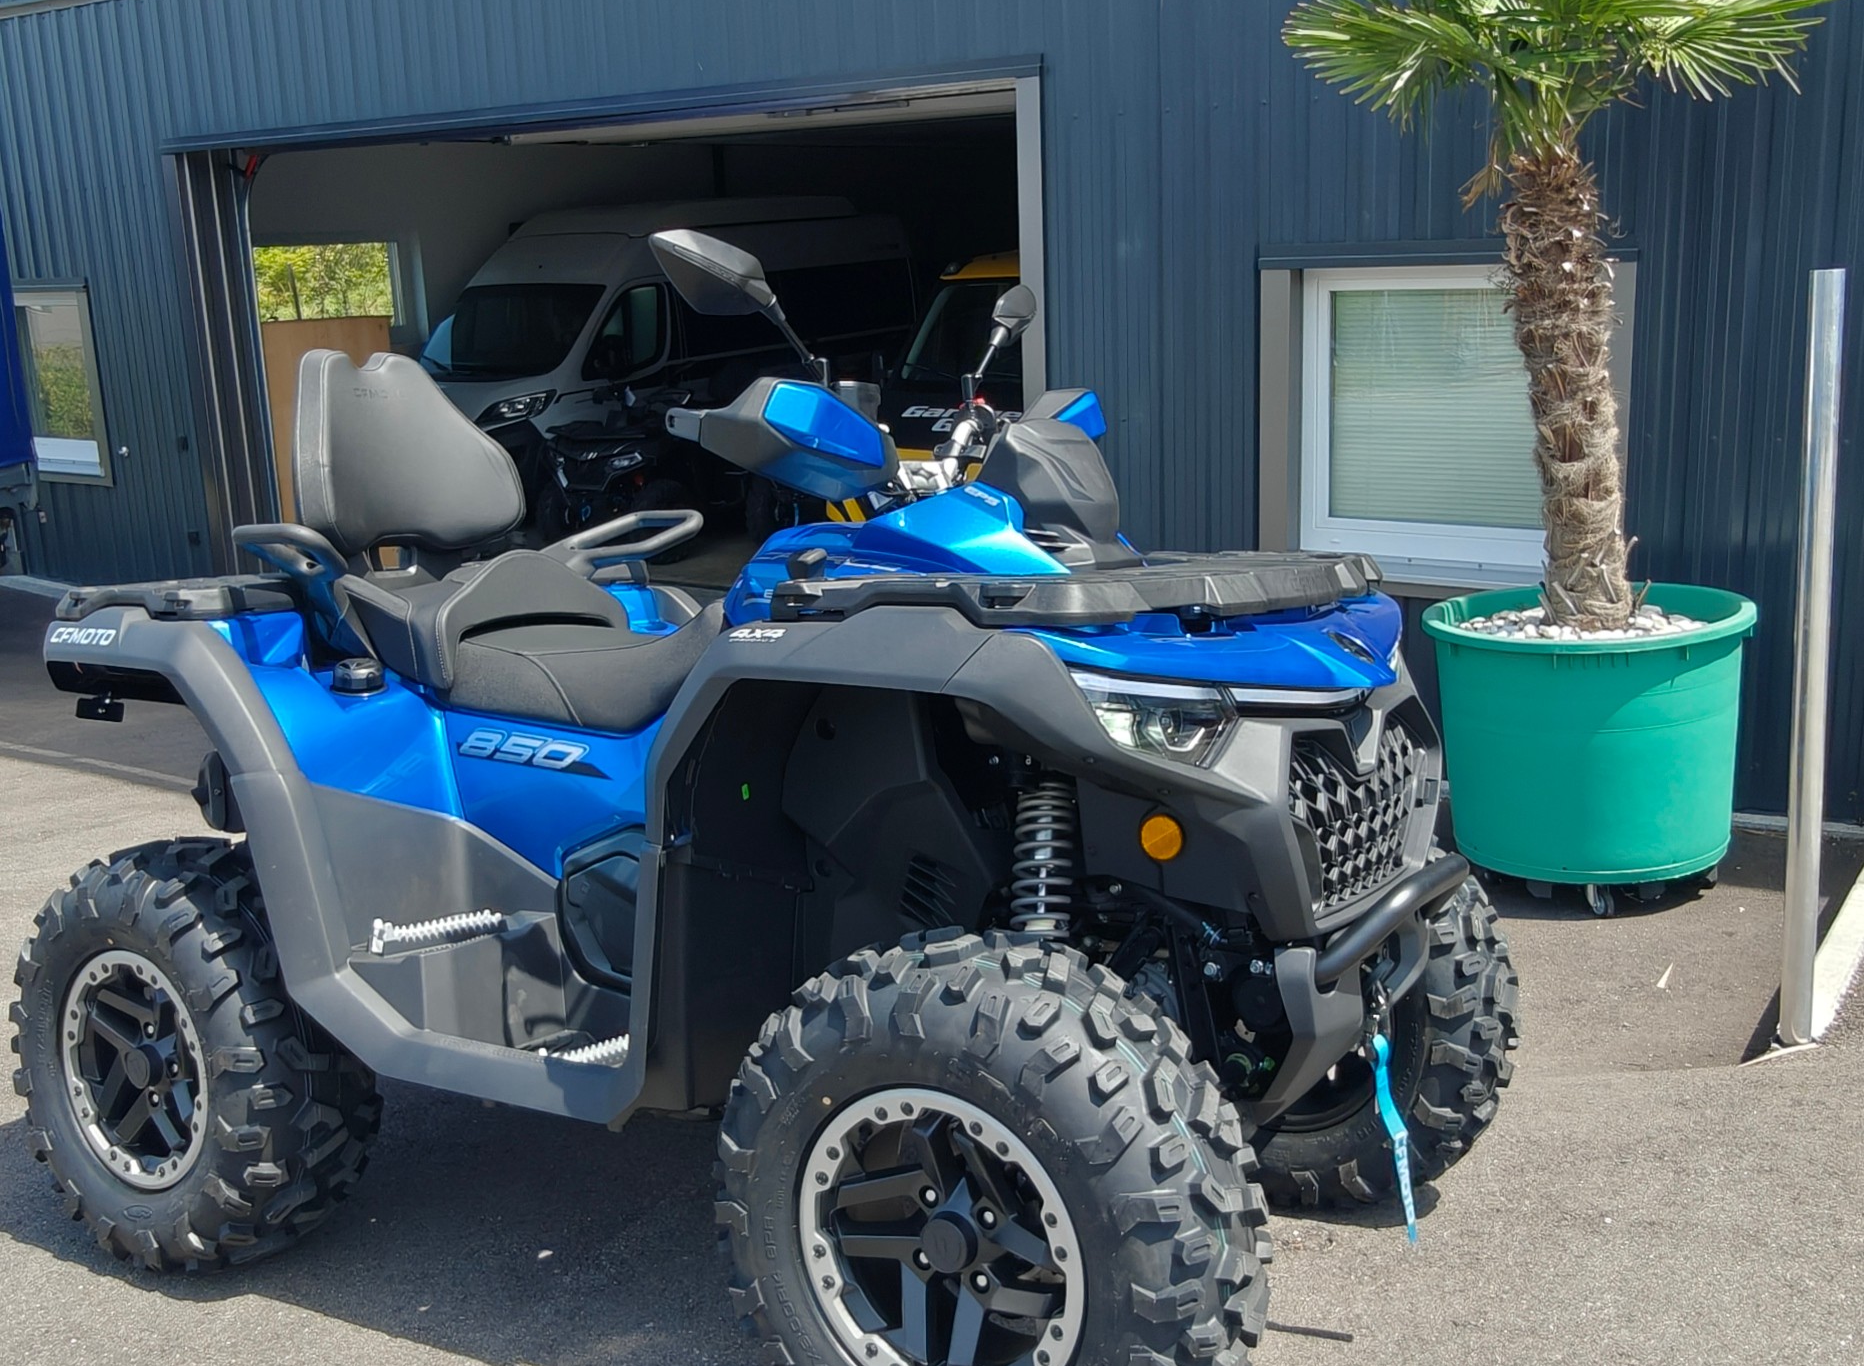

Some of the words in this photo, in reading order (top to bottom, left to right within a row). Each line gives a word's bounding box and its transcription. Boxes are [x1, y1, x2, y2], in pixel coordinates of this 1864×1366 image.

[901, 405, 1023, 421] Gare
[49, 627, 117, 646] CFMOTO
[459, 727, 590, 770] 850
